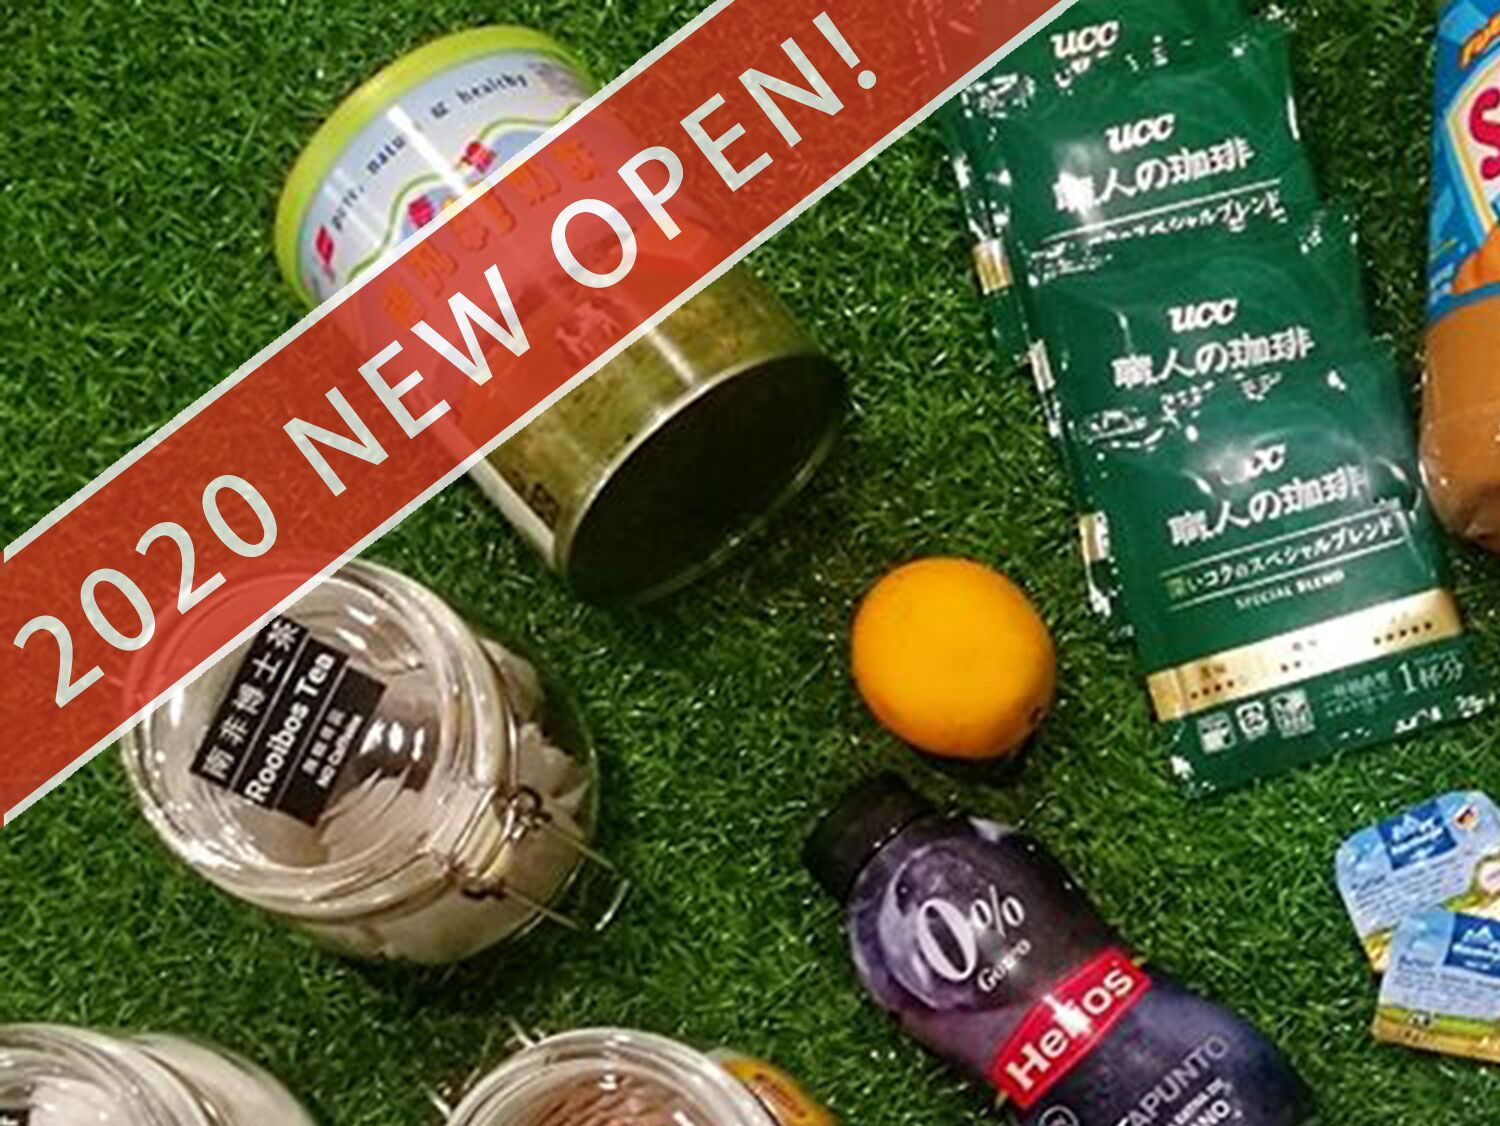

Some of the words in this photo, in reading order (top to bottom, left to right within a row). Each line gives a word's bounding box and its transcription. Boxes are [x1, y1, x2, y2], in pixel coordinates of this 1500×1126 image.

[202, 617, 301, 781] 南非博士茶
[244, 702, 311, 803] Rooibos
[294, 652, 336, 698] Tea
[917, 884, 1026, 983] 0%
[1005, 968, 1136, 1092] Helios
